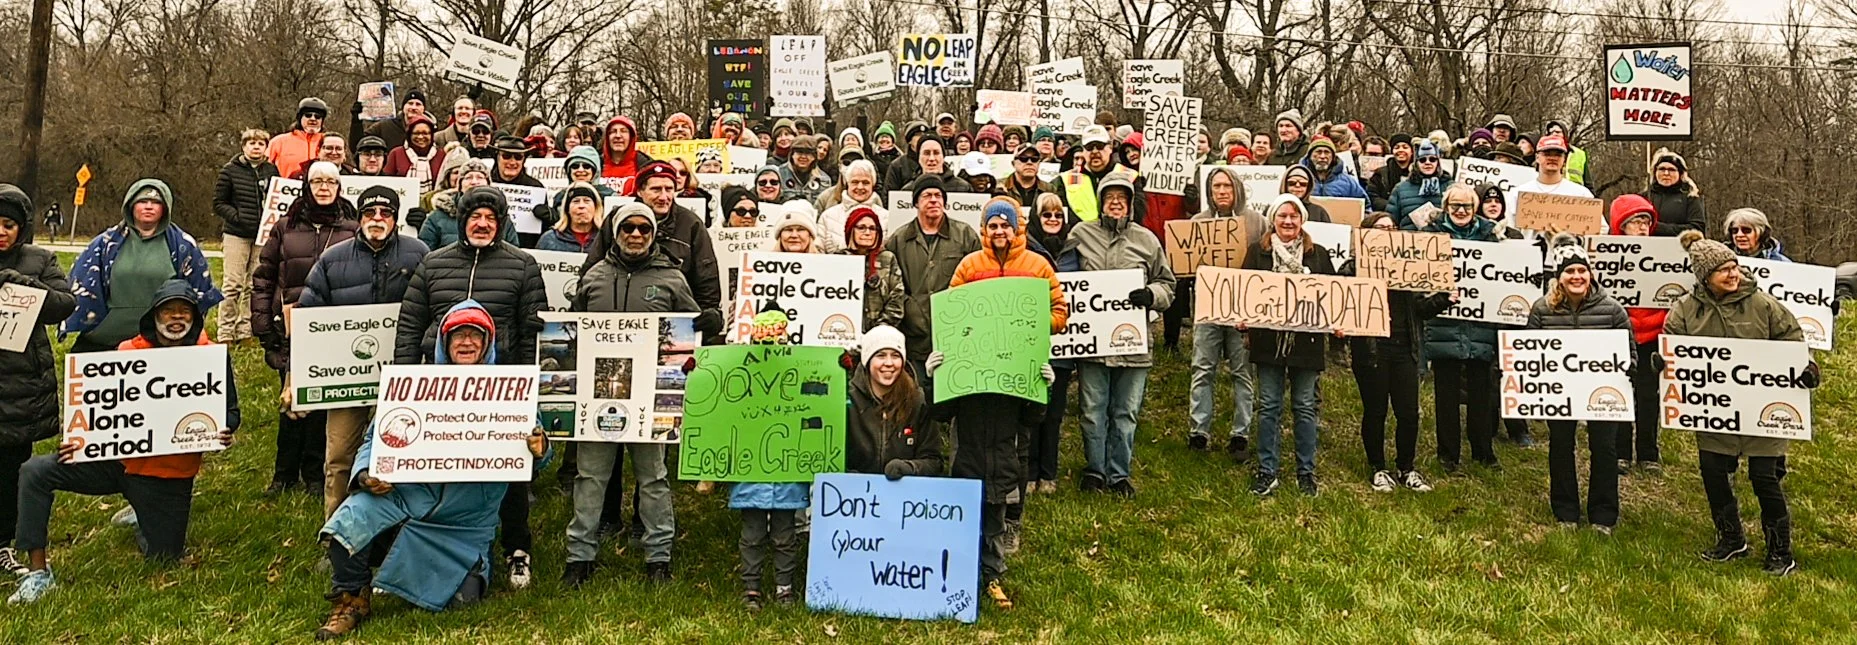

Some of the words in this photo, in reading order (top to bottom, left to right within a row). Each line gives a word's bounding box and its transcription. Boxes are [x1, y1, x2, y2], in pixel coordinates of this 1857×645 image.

[713, 46, 762, 55] LEBANON
[781, 39, 816, 51] LEAP
[903, 37, 941, 61] NO
[944, 38, 974, 58] LEAP
[725, 62, 751, 72] WTF!
[784, 54, 806, 62] OFF
[1126, 61, 1153, 71] Leave
[1633, 50, 1690, 81] Water
[453, 61, 472, 72] Save
[488, 71, 510, 84] Water
[899, 63, 940, 87] EAGLE
[1055, 69, 1083, 83] Creek
[1126, 73, 1151, 87] Eagle
[1153, 72, 1182, 84] Creek
[723, 79, 752, 89] SAVE
[838, 88, 854, 96] Save
[867, 81, 889, 89] Water
[1031, 84, 1063, 95] Leave
[725, 101, 758, 112] PARK!
[727, 92, 749, 102] OUR
[1031, 96, 1060, 111] Eagle
[1062, 97, 1094, 110] Creek
[1149, 95, 1197, 116] SAVE
[1610, 87, 1692, 110] MATTERS
[1030, 108, 1061, 119] Alone
[1145, 112, 1198, 131] EAGLE
[1145, 128, 1196, 146] CREEK
[660, 143, 694, 155] EAGLE
[1143, 144, 1195, 162] WATER
[1153, 162, 1183, 173] AND
[1254, 172, 1279, 181] Creek
[1460, 158, 1501, 176] Leave
[952, 201, 982, 211] Creek
[1521, 208, 1543, 220] SAVE
[1546, 211, 1561, 220] THE
[745, 230, 771, 241] EAGLE
[1168, 218, 1240, 249] WATER
[1360, 230, 1391, 261] Keep
[1390, 231, 1426, 260] Water
[1588, 237, 1641, 254] Leave
[742, 252, 803, 275] Leave
[1360, 256, 1371, 278] 4
[1374, 259, 1399, 280] the
[1403, 261, 1449, 283] Eagles
[1639, 256, 1694, 274] Creek
[1481, 264, 1537, 285] Creek
[1598, 272, 1636, 289] lone
[741, 276, 796, 302] Eagle
[800, 279, 861, 300] Creek
[1769, 283, 1832, 308] Creek
[939, 289, 1038, 324] Save
[1200, 272, 1243, 319] YOU
[1244, 274, 1284, 319] Can't
[1330, 280, 1387, 331] DATA
[309, 320, 341, 334] Save
[344, 318, 381, 335] Eagle
[618, 317, 650, 330] EAGLE
[936, 317, 1026, 368] Eagle
[1051, 336, 1097, 356] eriod
[1502, 332, 1562, 351] Leave
[1662, 337, 1732, 361] Leave
[69, 357, 148, 379] Leave
[309, 364, 346, 379] Save
[349, 362, 375, 376] our
[1502, 353, 1559, 378] Eagle
[1562, 353, 1627, 373] Creek
[1663, 360, 1727, 388] Eagle
[1732, 364, 1808, 389] Creek
[685, 349, 798, 416] Save
[947, 359, 1042, 397] Creek
[1503, 374, 1563, 394] Alone
[69, 379, 142, 410] Eagle
[146, 372, 223, 400] Creek
[384, 377, 413, 401] NO
[414, 377, 459, 401] DATA
[461, 377, 534, 401] CENTER!
[1662, 384, 1732, 407] Alone
[1504, 397, 1572, 417] Period
[67, 408, 146, 433] Alone
[425, 412, 466, 423] Protect
[467, 413, 488, 423] Our
[490, 413, 529, 423] Homes
[1664, 406, 1740, 432] Period
[423, 430, 463, 441] Protect
[465, 430, 486, 441] Our
[487, 430, 529, 441] Forests
[68, 430, 154, 461] Period
[681, 425, 753, 478] Eagle
[760, 422, 841, 476] Creek
[396, 457, 526, 471] PROTECTINDY.ORG
[821, 480, 881, 518] Don't
[901, 498, 964, 530] poison
[832, 529, 885, 559] (y)our
[946, 589, 966, 606] STOP
